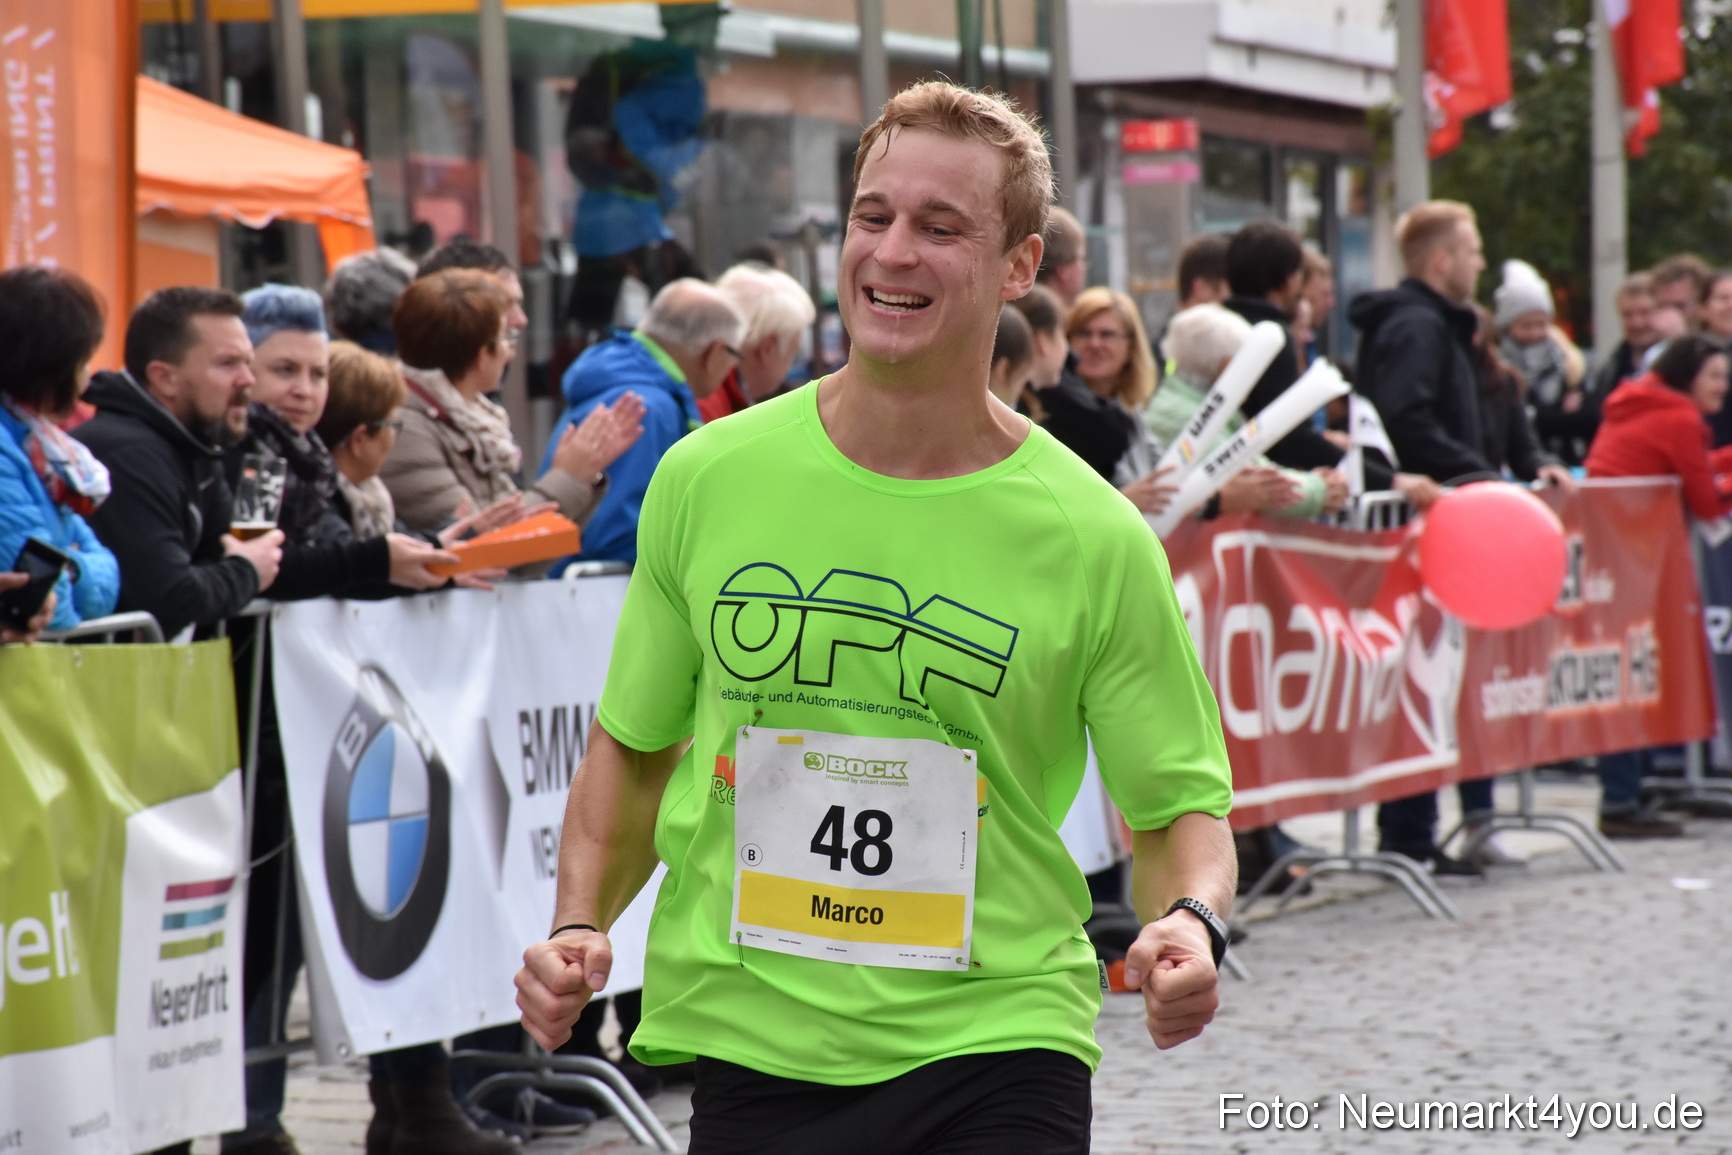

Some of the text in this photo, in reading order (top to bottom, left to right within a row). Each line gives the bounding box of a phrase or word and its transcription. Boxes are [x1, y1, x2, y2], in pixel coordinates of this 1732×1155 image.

[711, 561, 1019, 710] OPF
[719, 686, 764, 703] ebäude-
[768, 691, 793, 703] und
[943, 723, 984, 746] GmbH
[825, 773, 910, 788] inspired by smart concepts
[826, 754, 908, 780] BOCK
[748, 849, 756, 861] B
[810, 804, 894, 877] 48
[811, 894, 884, 926] Marco
